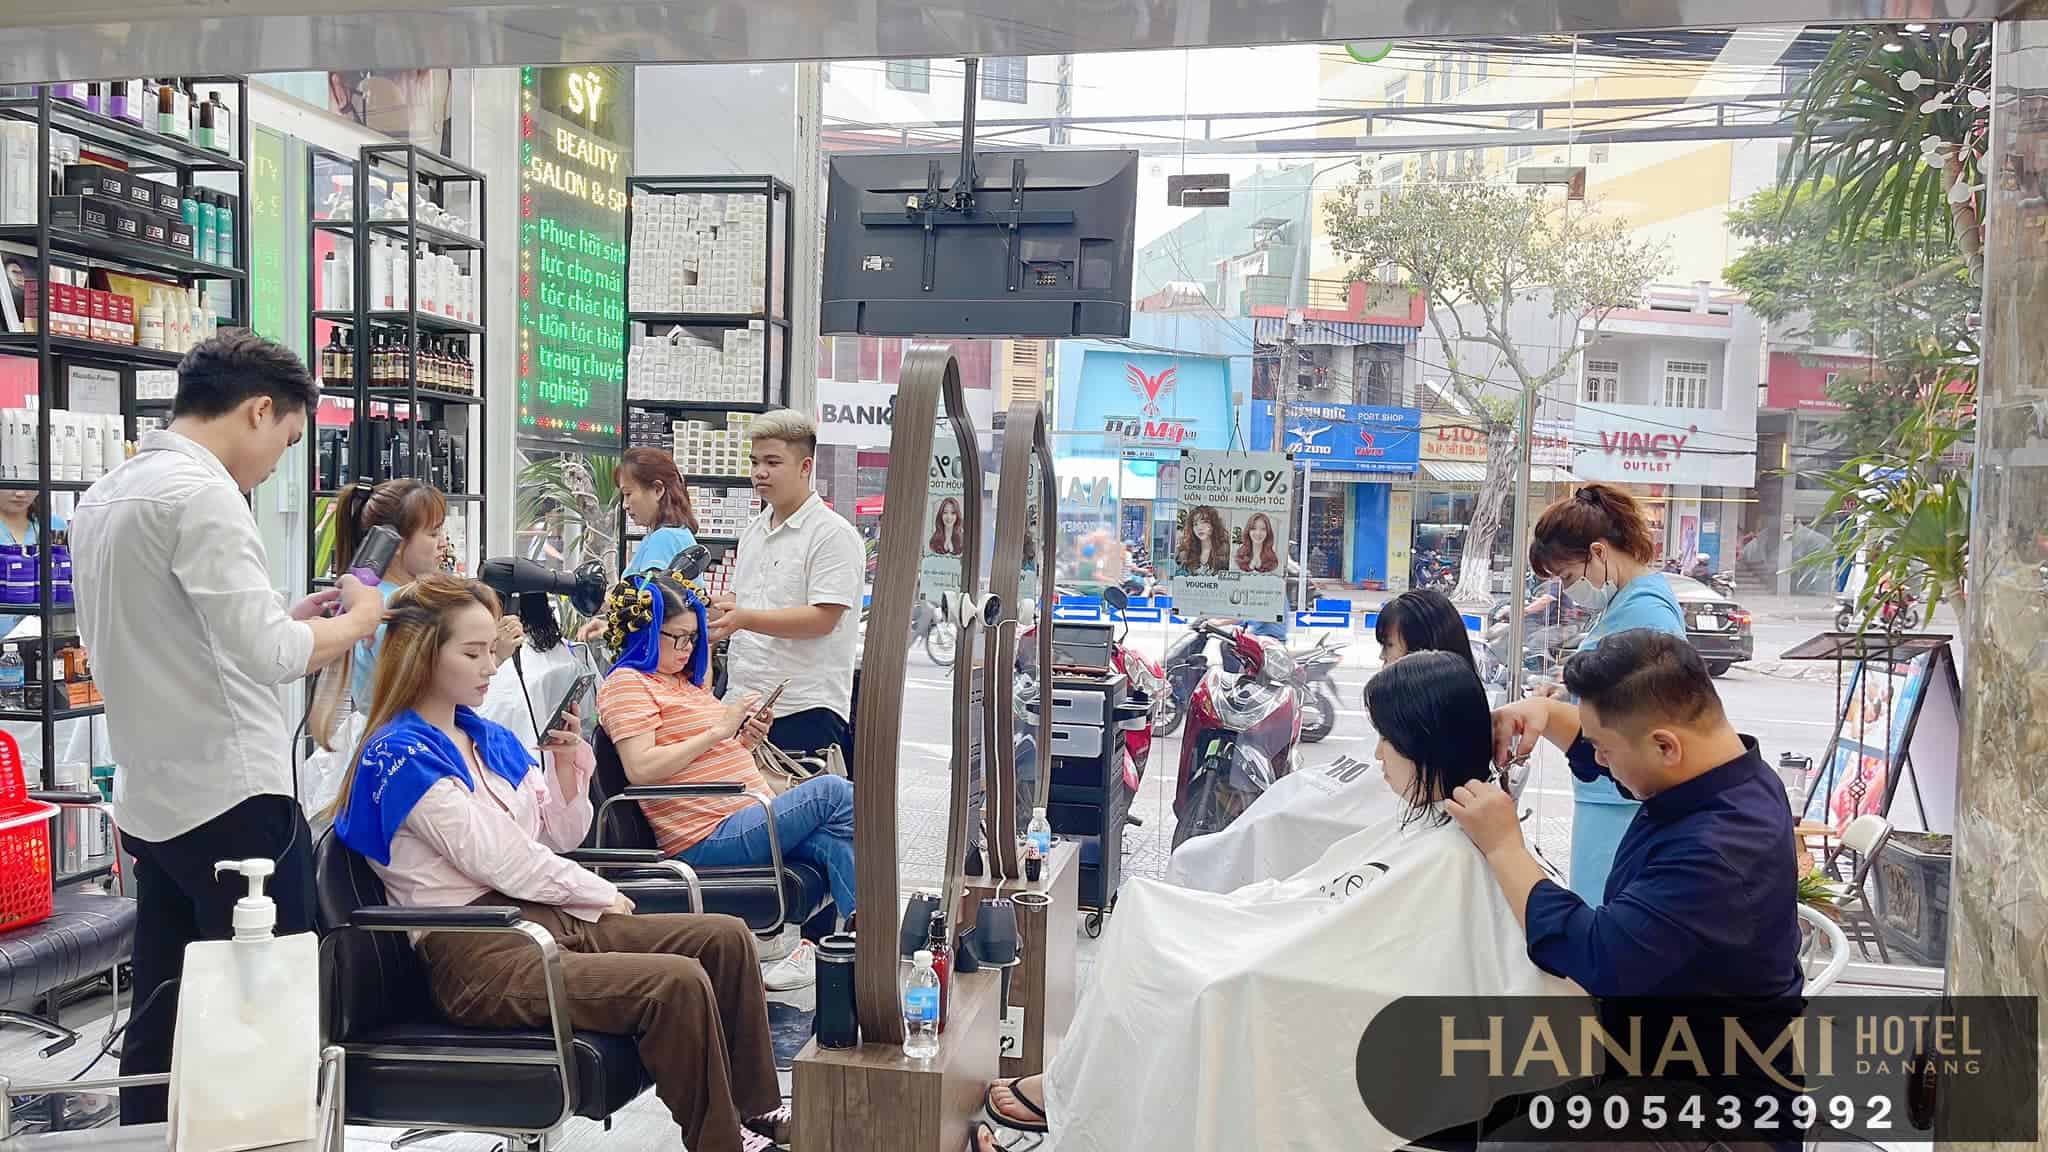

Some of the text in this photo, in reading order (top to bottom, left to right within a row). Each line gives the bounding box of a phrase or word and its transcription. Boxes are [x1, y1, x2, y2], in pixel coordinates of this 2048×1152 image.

[568, 71, 603, 122] SỸ
[557, 127, 617, 174] BEAUTY
[531, 156, 628, 213] SALON & SP
[541, 218, 576, 251] Phục
[568, 259, 592, 284] cho
[596, 270, 620, 293] mái
[541, 282, 565, 308] tóc
[571, 321, 593, 345] tóc
[540, 345, 624, 383] trang chuyê
[539, 377, 588, 408] nghiệp
[1600, 431, 1688, 459] VINCY
[1184, 463, 1288, 494] GIẢM 10%
[1623, 462, 1672, 472] OUTLET
[1186, 581, 1218, 589] VOUCHER
